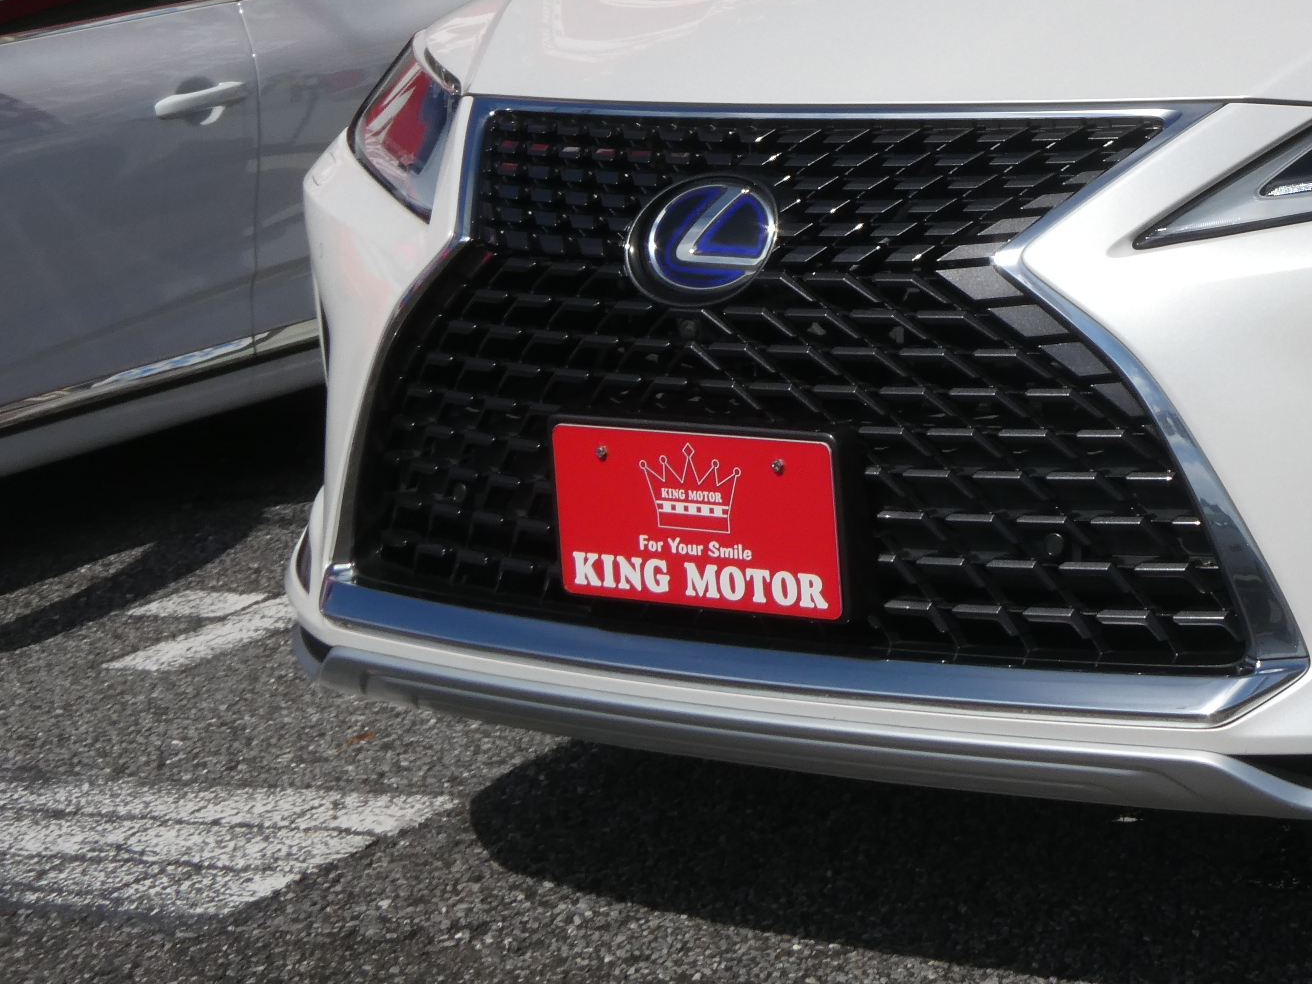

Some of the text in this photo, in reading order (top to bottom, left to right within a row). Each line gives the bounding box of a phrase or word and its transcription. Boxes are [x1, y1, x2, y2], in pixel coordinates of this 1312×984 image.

[660, 487, 723, 503] KING MOTOR
[639, 534, 752, 561] For Your Smile
[572, 551, 829, 609] KING MOTOR
